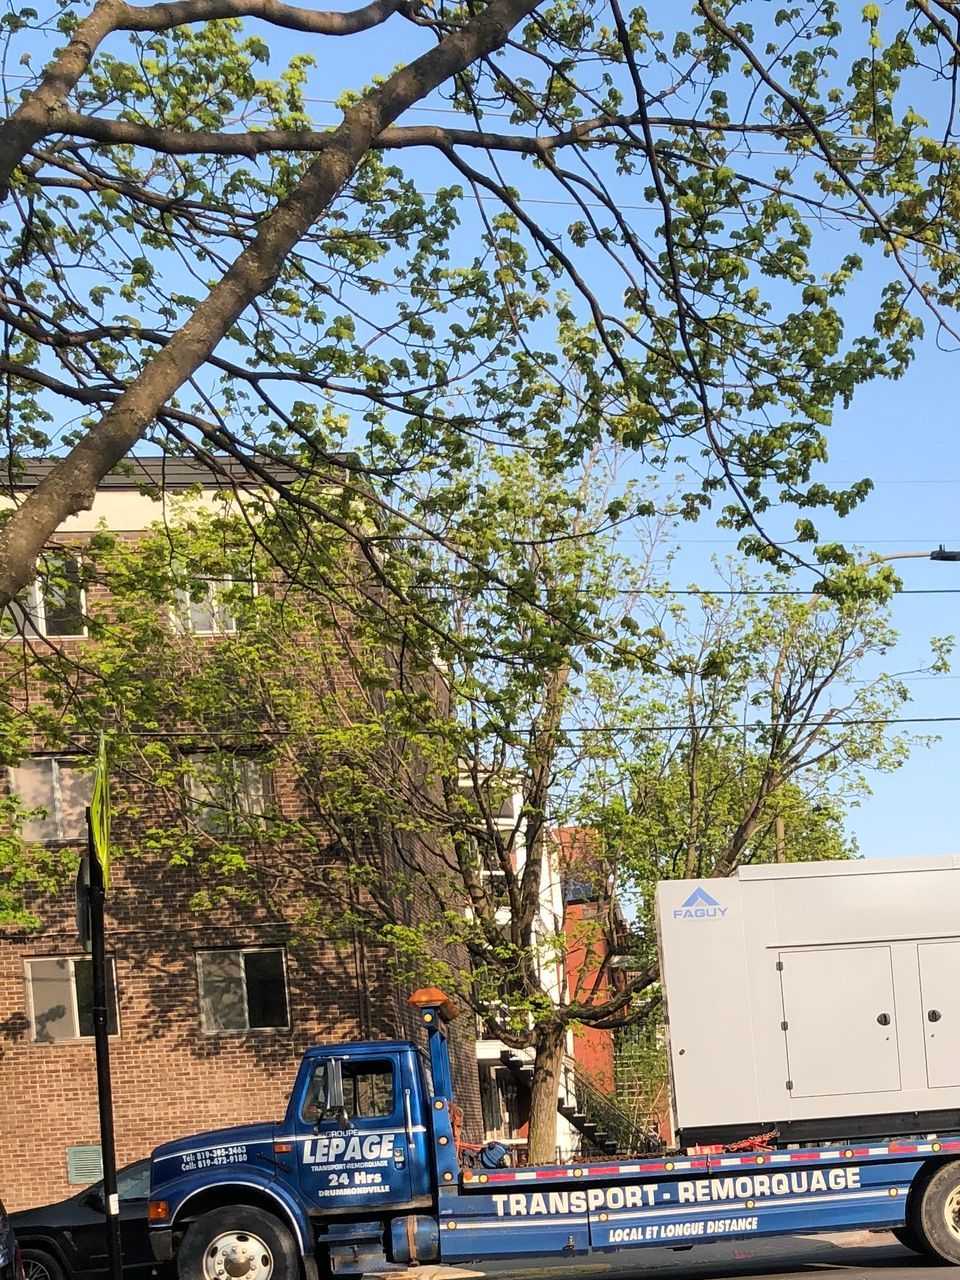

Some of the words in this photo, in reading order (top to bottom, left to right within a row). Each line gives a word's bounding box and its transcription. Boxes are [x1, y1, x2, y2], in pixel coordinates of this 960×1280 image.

[673, 907, 728, 919] FAGUY
[325, 1129, 359, 1138] GROUPE
[302, 1134, 395, 1164] LEPAGE
[328, 1172, 350, 1186] 24
[354, 1171, 382, 1185] Hrs
[318, 1185, 390, 1197] DRUMMONDVILLE
[492, 1184, 659, 1217] TRANSPORT
[677, 1167, 862, 1203] REMORQUAGE
[609, 1226, 643, 1242] LOCAL
[645, 1226, 659, 1239] ET
[660, 1222, 705, 1238] LONGUE
[706, 1217, 759, 1234] DISTANCE
